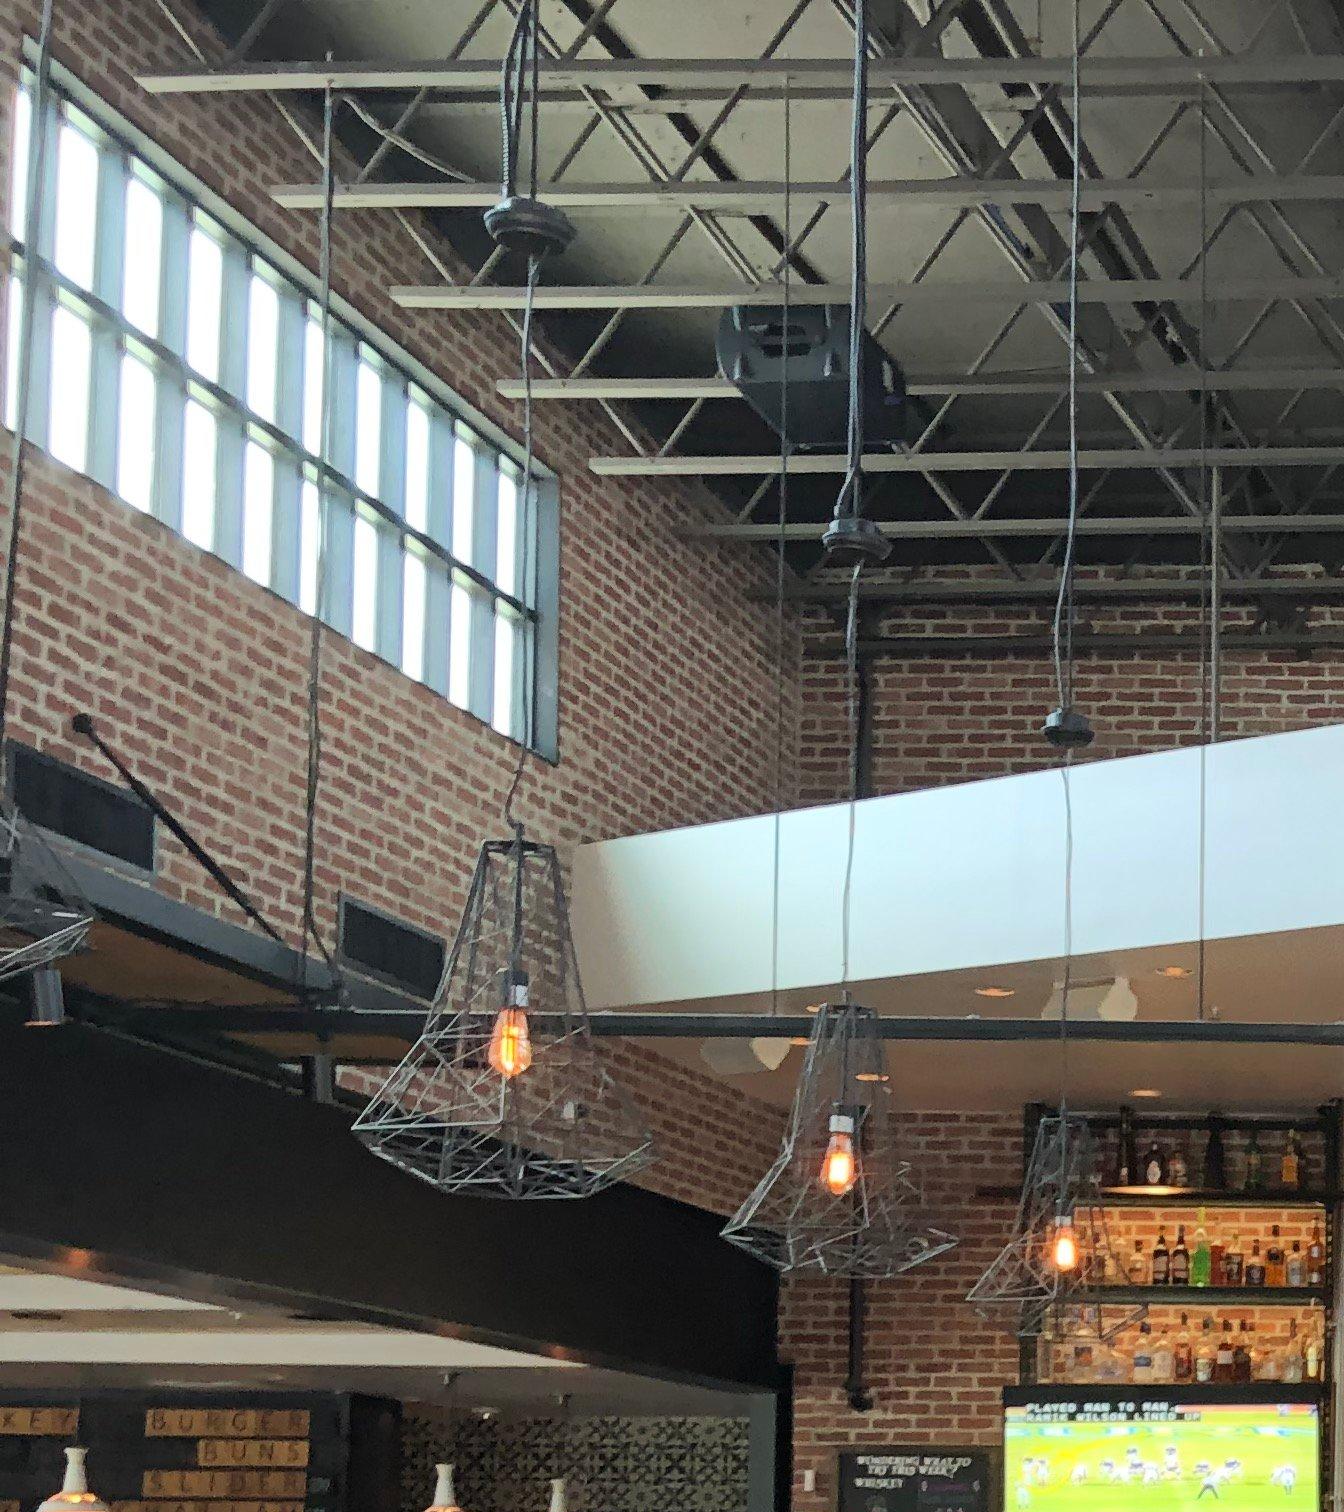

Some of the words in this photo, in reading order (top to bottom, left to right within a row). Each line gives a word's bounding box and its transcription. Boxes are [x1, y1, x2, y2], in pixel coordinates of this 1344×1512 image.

[1026, 1402, 1076, 1413] PLAYED
[1083, 1402, 1110, 1412] MAN
[1118, 1402, 1135, 1412] TO
[203, 1441, 300, 1461] BUNS
